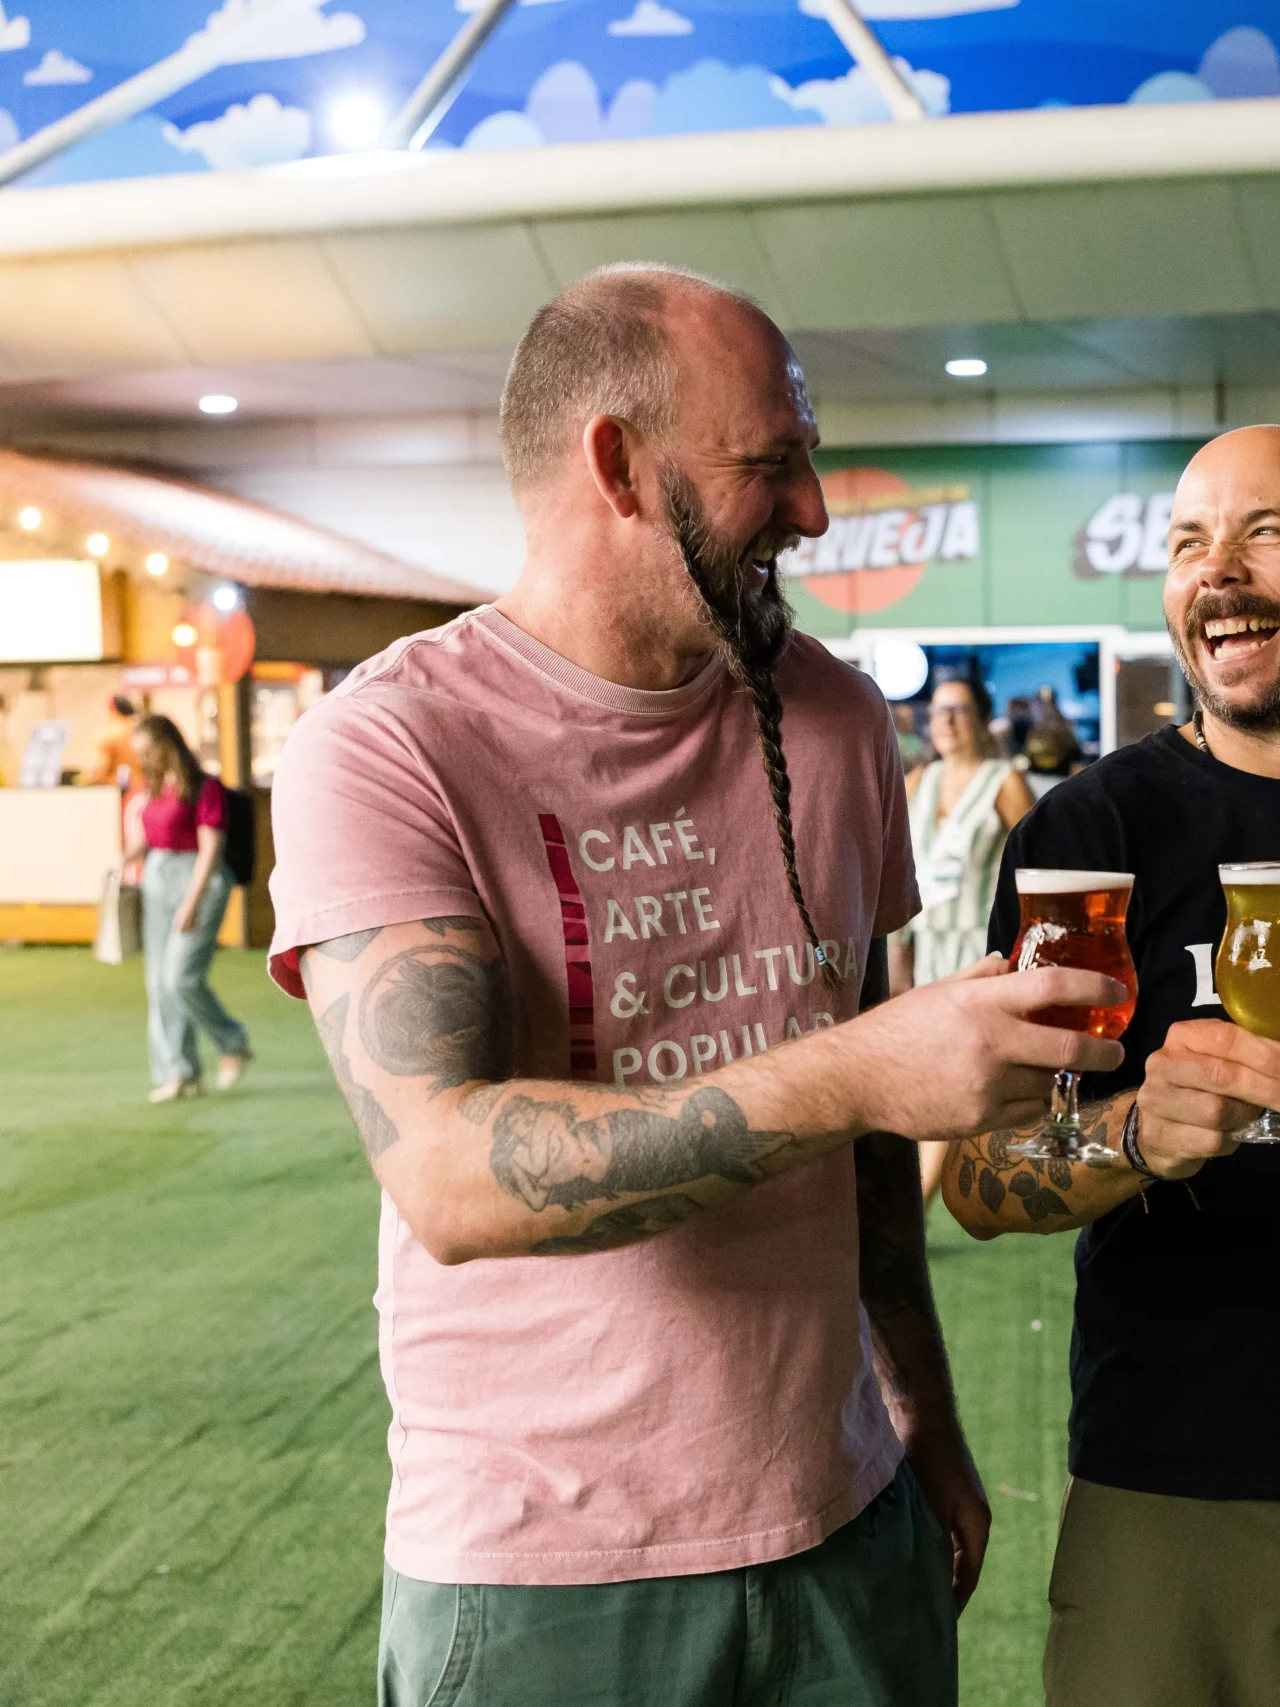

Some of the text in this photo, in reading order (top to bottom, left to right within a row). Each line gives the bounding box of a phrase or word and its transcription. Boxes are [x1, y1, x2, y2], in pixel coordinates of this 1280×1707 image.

[776, 501, 980, 578] ERVEJA
[1085, 492, 1176, 572] SE
[577, 806, 716, 872] CAFÉ,
[603, 887, 721, 944] ARTE
[609, 936, 859, 1019] & CULTURA
